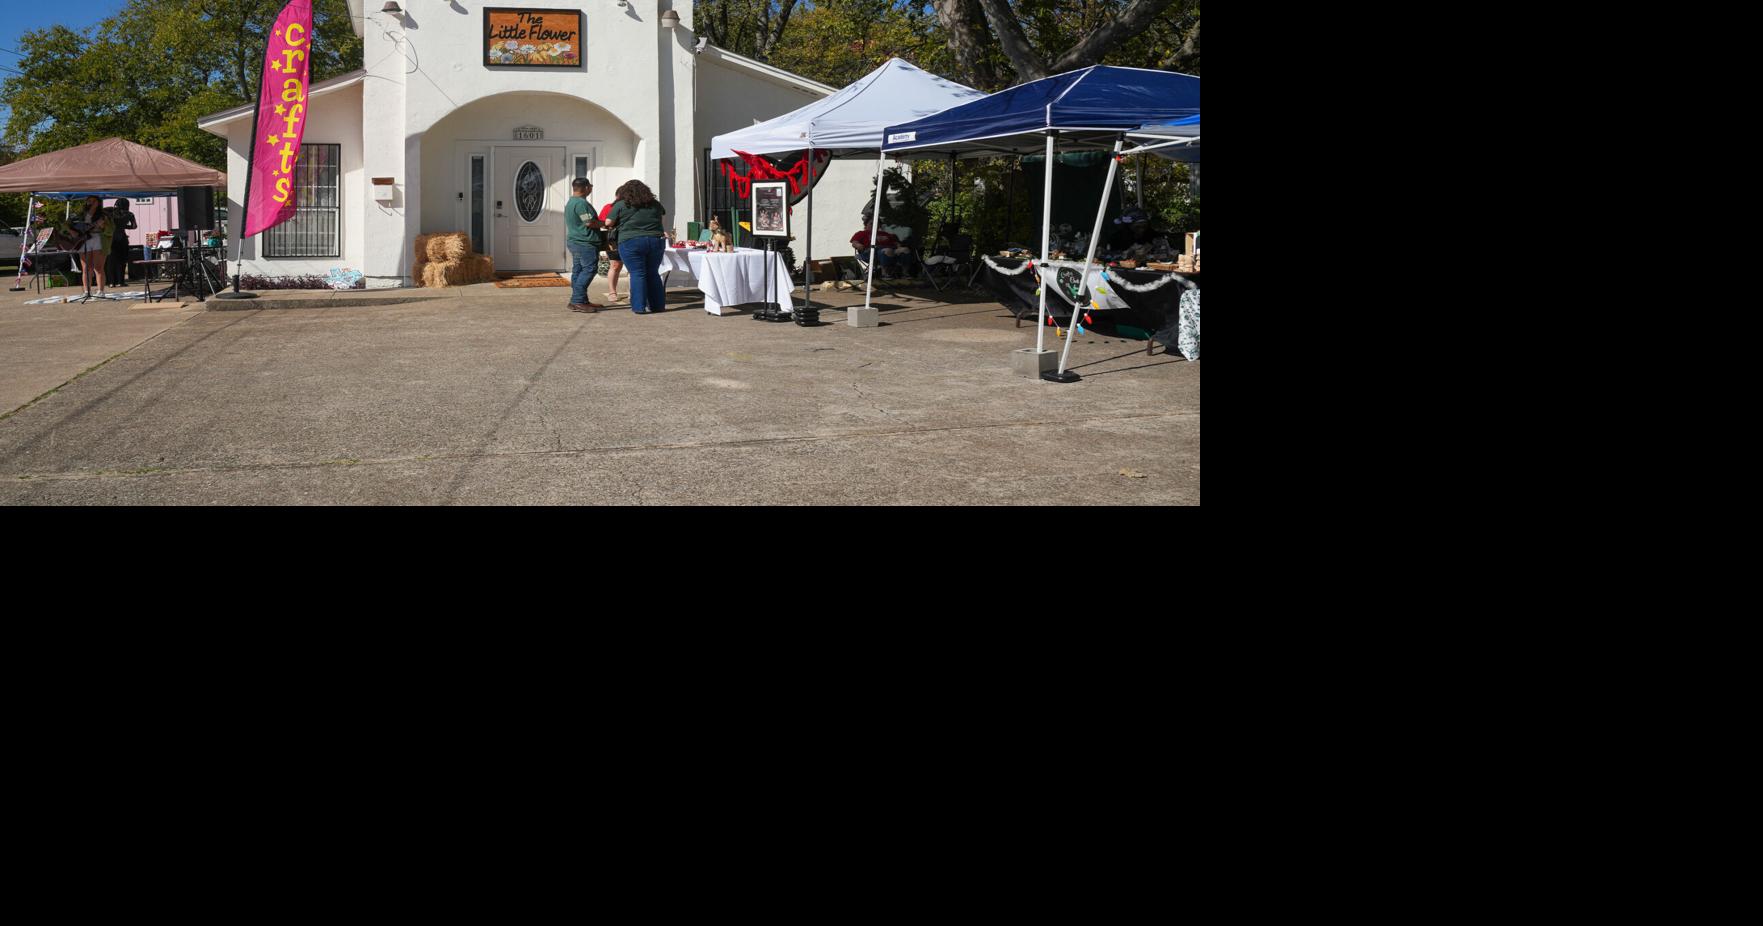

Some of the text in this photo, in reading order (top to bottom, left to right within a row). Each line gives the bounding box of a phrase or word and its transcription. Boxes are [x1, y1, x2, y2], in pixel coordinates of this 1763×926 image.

[517, 12, 543, 24] The
[488, 24, 577, 41] Little Flower
[272, 23, 306, 203] crafts
